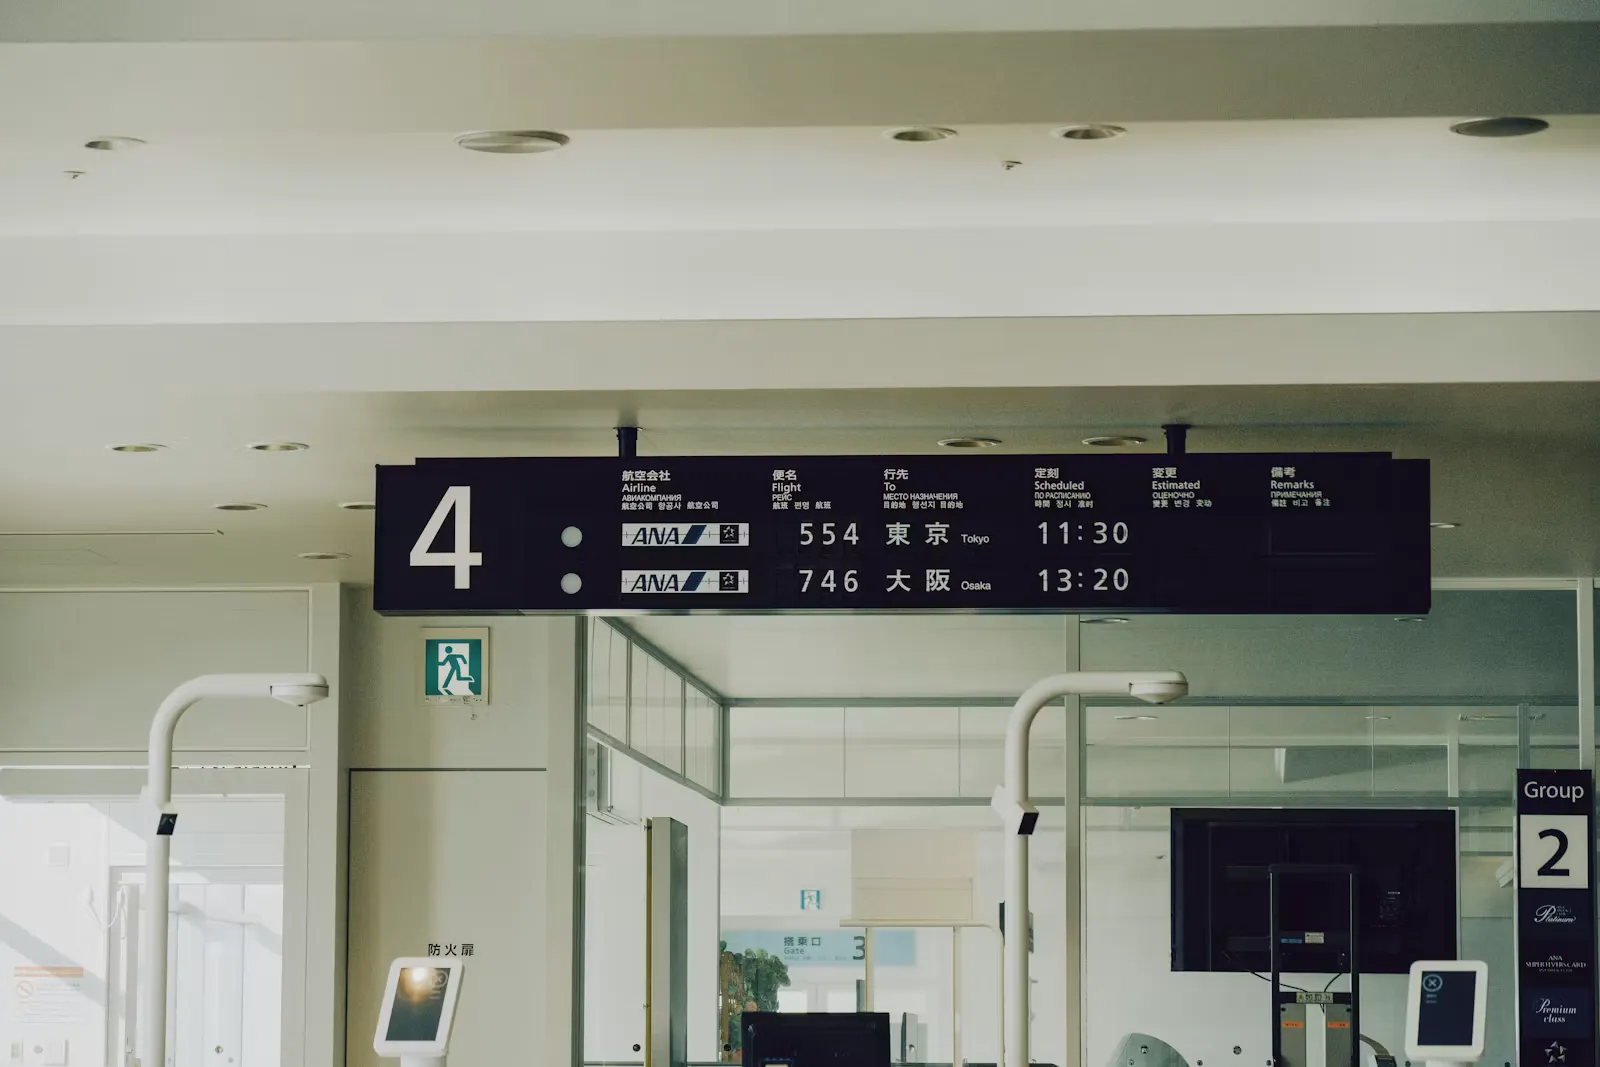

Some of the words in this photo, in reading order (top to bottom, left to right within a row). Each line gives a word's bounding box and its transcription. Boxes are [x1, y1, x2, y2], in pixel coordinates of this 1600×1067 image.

[621, 470, 671, 481] 航空会社
[772, 469, 797, 481] 便名
[883, 469, 908, 480] 行先
[1034, 467, 1059, 479] 定刻
[1152, 467, 1177, 478] 変更
[1271, 467, 1296, 478] 備考
[622, 484, 656, 492] Airline
[772, 483, 801, 494] Flight
[884, 482, 896, 491] To
[1034, 481, 1084, 490] Scheduled
[1152, 481, 1200, 490] Estimated
[1270, 480, 1314, 489] Remarks
[1152, 492, 1195, 500] ОЦЕНОЧНО
[621, 502, 653, 510] 航空公司
[687, 501, 719, 509] 航空公司
[883, 501, 906, 509] 目的地
[940, 500, 963, 508] 目的地
[409, 485, 482, 589] 4
[632, 527, 680, 544] ANA
[800, 523, 859, 545] 554
[886, 522, 950, 545] 東京
[961, 534, 990, 545] Tokyo
[1038, 522, 1129, 544] 11:30
[631, 574, 679, 592] ANA
[799, 569, 859, 593] 746
[886, 569, 950, 592] 大阪
[961, 581, 991, 590] Osaka
[1038, 568, 1129, 592] 13:20
[1524, 781, 1584, 802] Group
[1537, 828, 1570, 876] 2
[1534, 904, 1576, 922] Platinum
[428, 944, 474, 956] 防火扉
[853, 936, 865, 960] 3
[1536, 998, 1576, 1014] Premium
[1544, 1014, 1565, 1023] class
